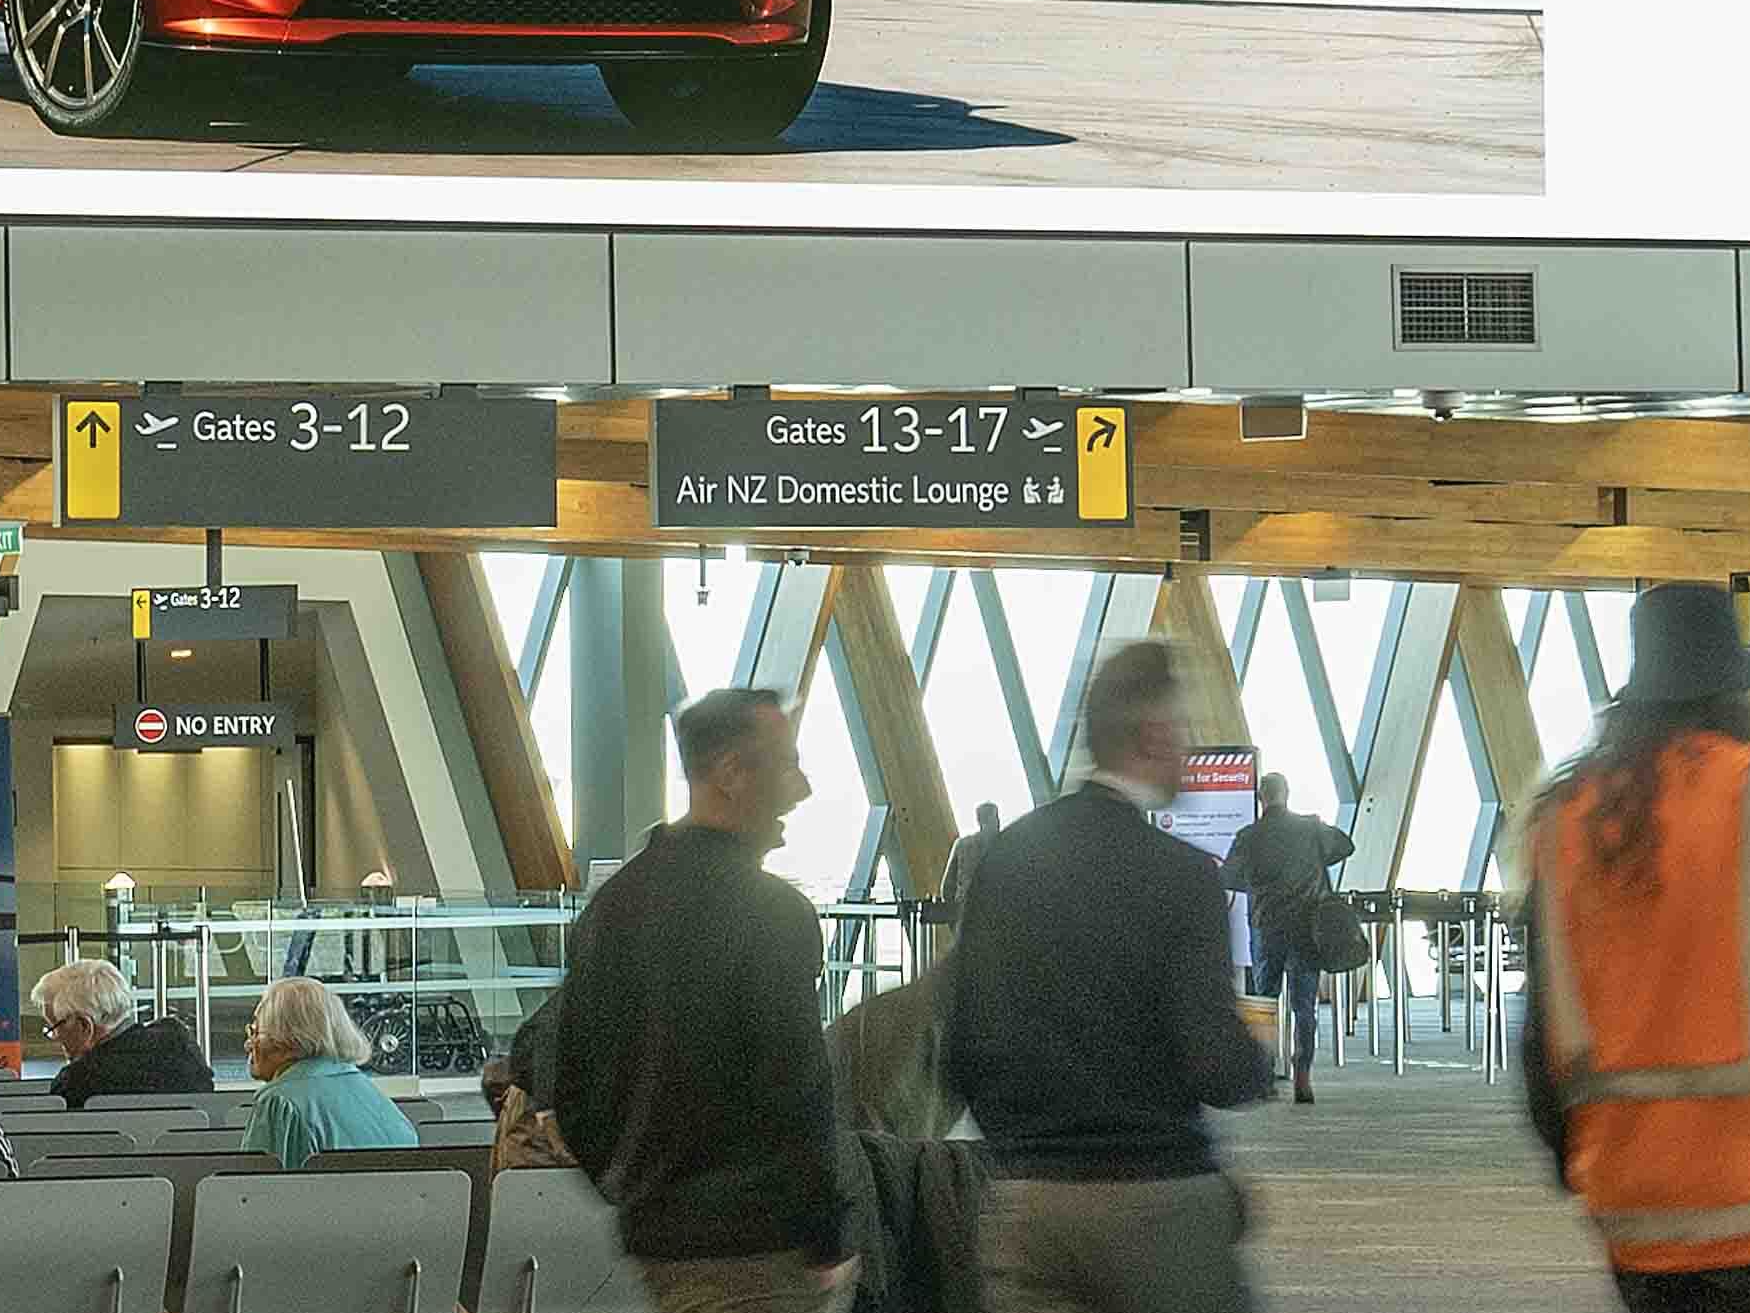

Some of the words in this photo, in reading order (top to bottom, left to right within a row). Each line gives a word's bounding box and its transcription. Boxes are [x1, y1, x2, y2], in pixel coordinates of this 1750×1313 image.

[193, 411, 276, 441] Gates
[290, 402, 410, 451] 3-12
[766, 415, 846, 444] Gates
[860, 406, 1008, 453] 13-17
[676, 475, 718, 504] Air
[727, 475, 768, 504] NZ
[778, 475, 903, 504] Domestic
[913, 475, 1009, 512] Lounge
[170, 592, 198, 607] Gates
[200, 587, 241, 609] 3-12
[176, 716, 207, 735] NO
[214, 716, 275, 735] ENTRY
